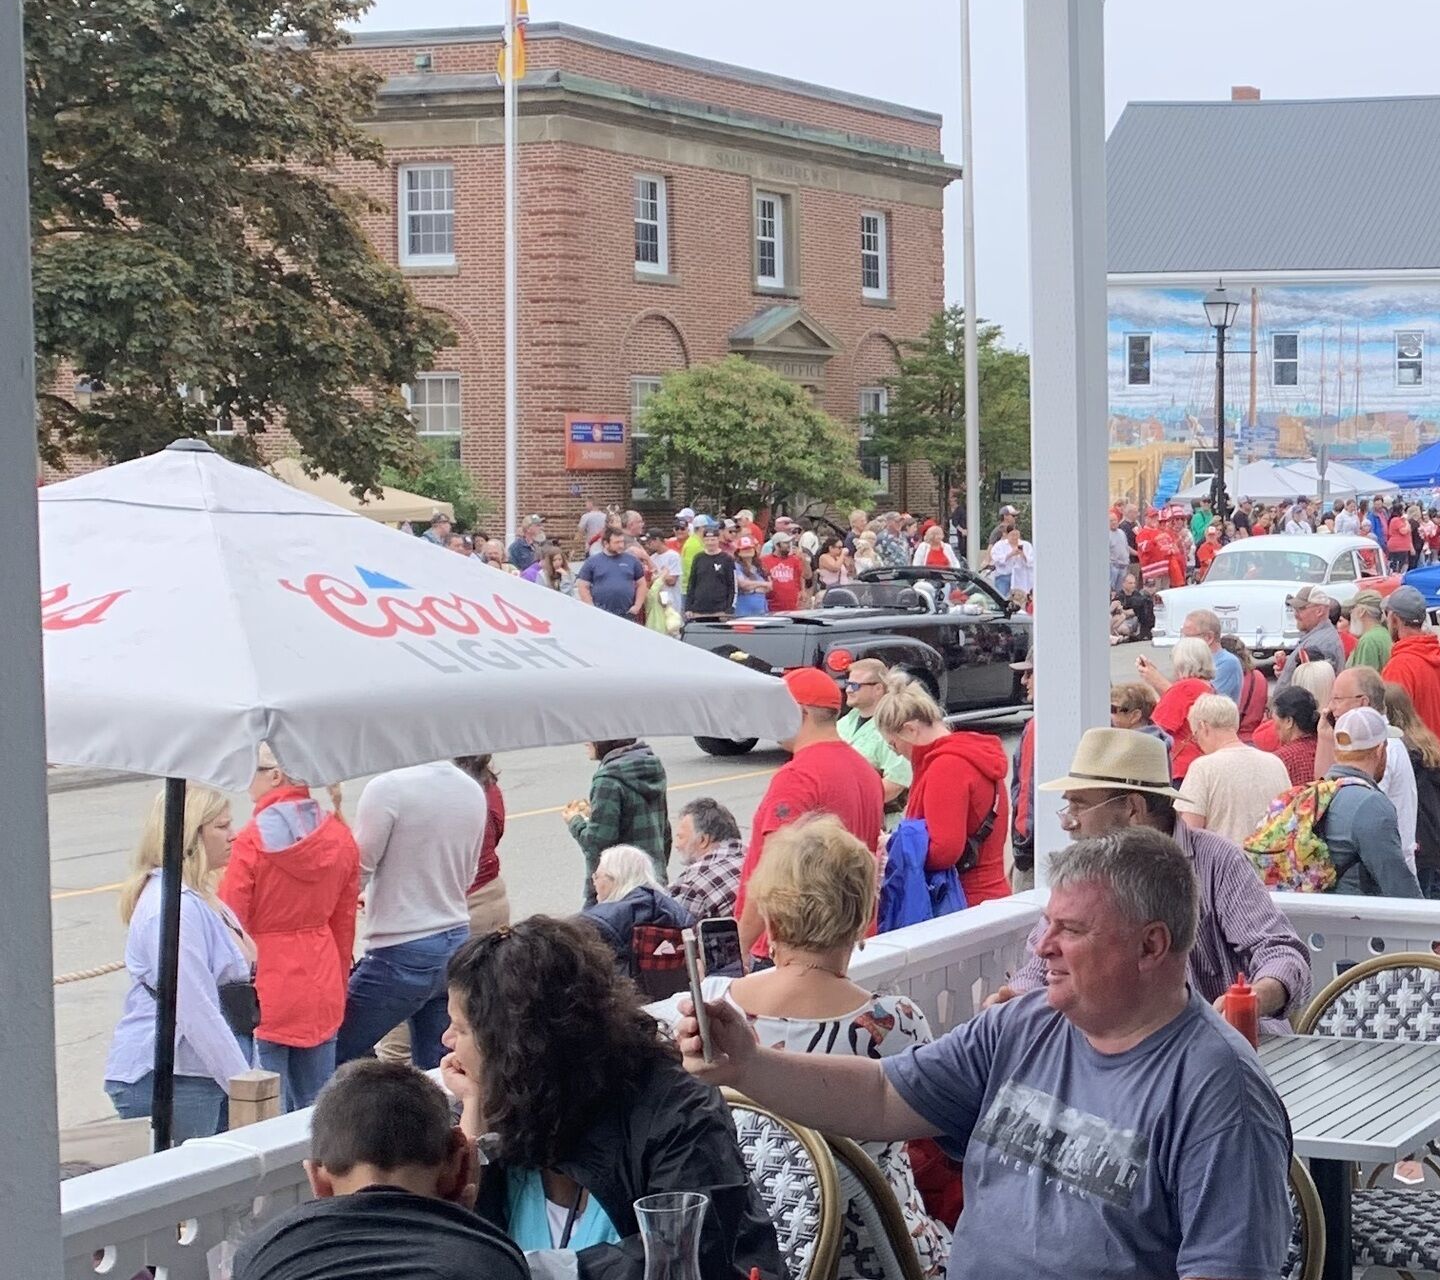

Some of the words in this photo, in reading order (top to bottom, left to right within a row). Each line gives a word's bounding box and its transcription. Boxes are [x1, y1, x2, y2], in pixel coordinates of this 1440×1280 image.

[716, 152, 752, 172] SAINT
[768, 160, 828, 182] ANDREWS
[784, 363, 822, 378] OFFICE
[278, 574, 551, 638] Coors
[395, 637, 591, 674] LIGHT
[999, 1154, 1037, 1178] NEW
[1044, 1177, 1090, 1200] YORK
